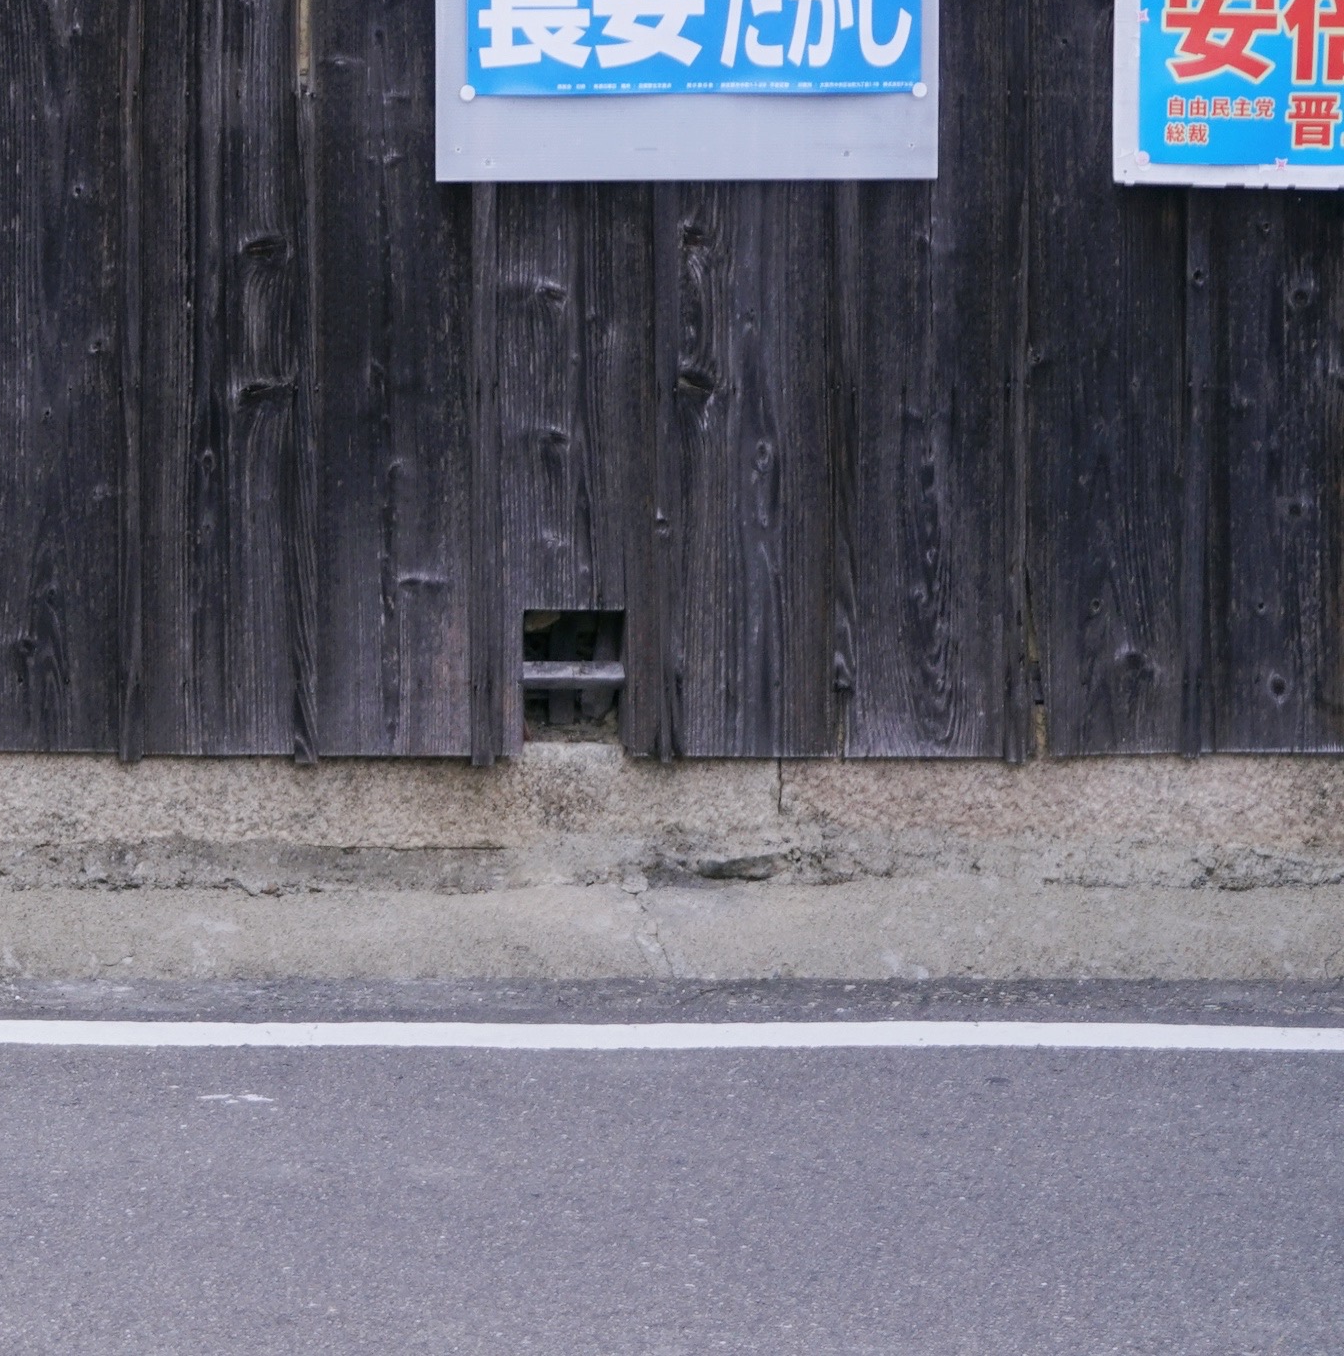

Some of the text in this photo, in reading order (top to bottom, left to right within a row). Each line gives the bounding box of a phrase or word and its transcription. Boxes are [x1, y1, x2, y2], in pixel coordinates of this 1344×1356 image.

[1168, 97, 1274, 118] 自由民主党
[1286, 93, 1344, 149] 晋
[1165, 123, 1208, 144] 総裁
